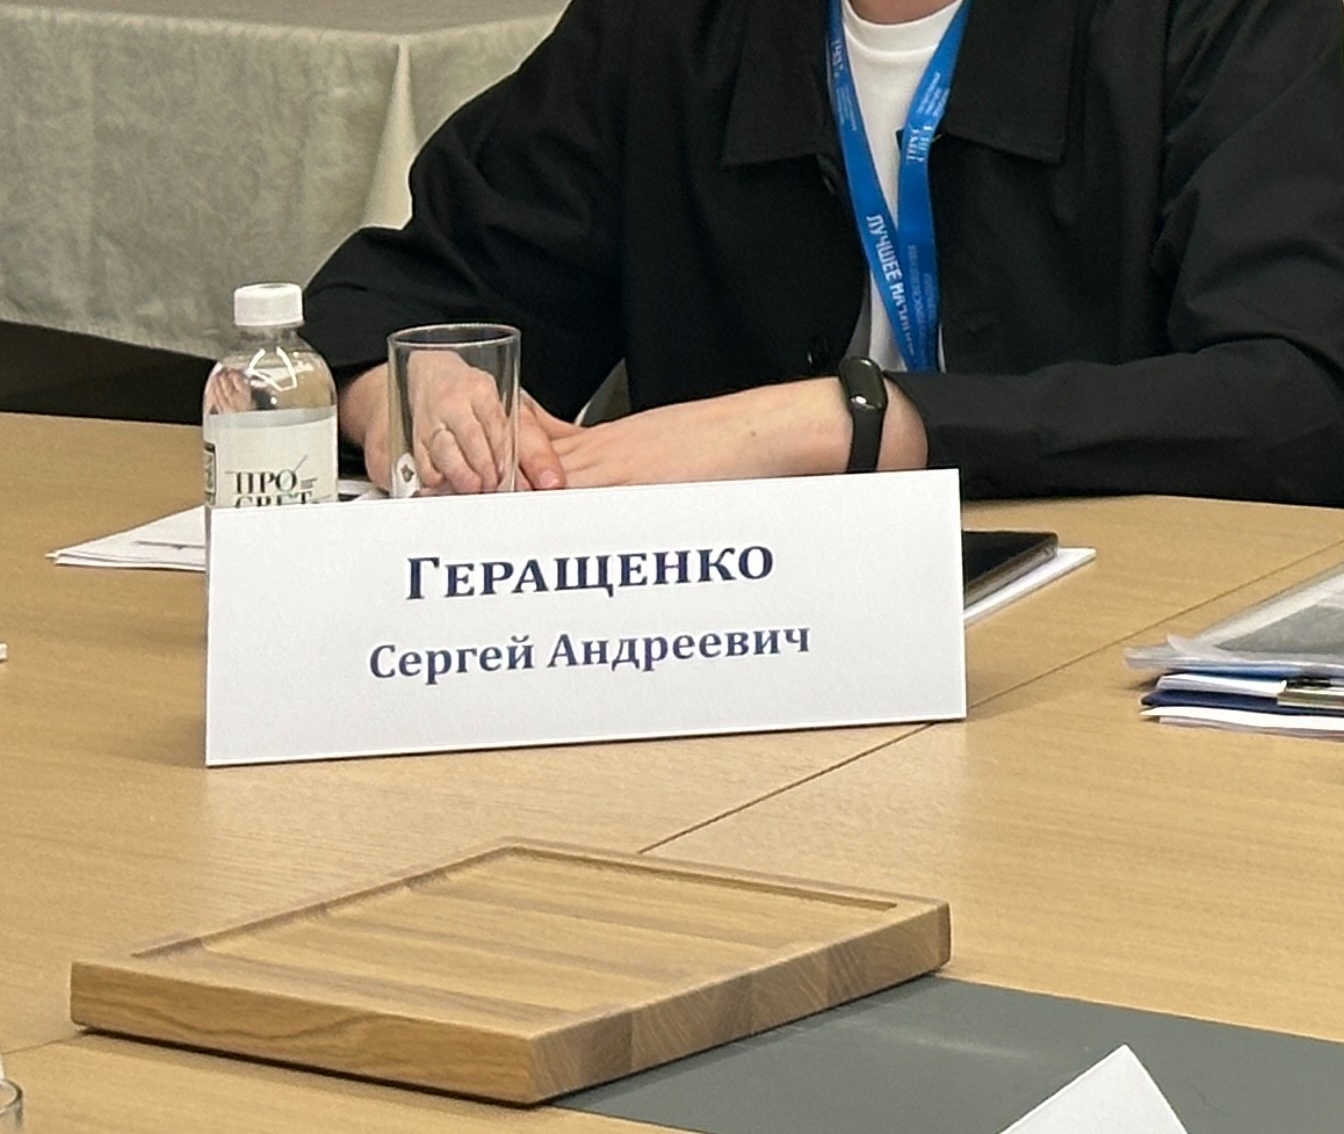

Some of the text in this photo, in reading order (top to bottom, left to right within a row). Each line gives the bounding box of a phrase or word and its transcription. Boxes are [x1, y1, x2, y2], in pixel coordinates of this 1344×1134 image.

[866, 213, 903, 282] ЛУЧШЕЕ
[235, 469, 298, 495] ПРО
[369, 627, 810, 686] Сергей Андреевич
